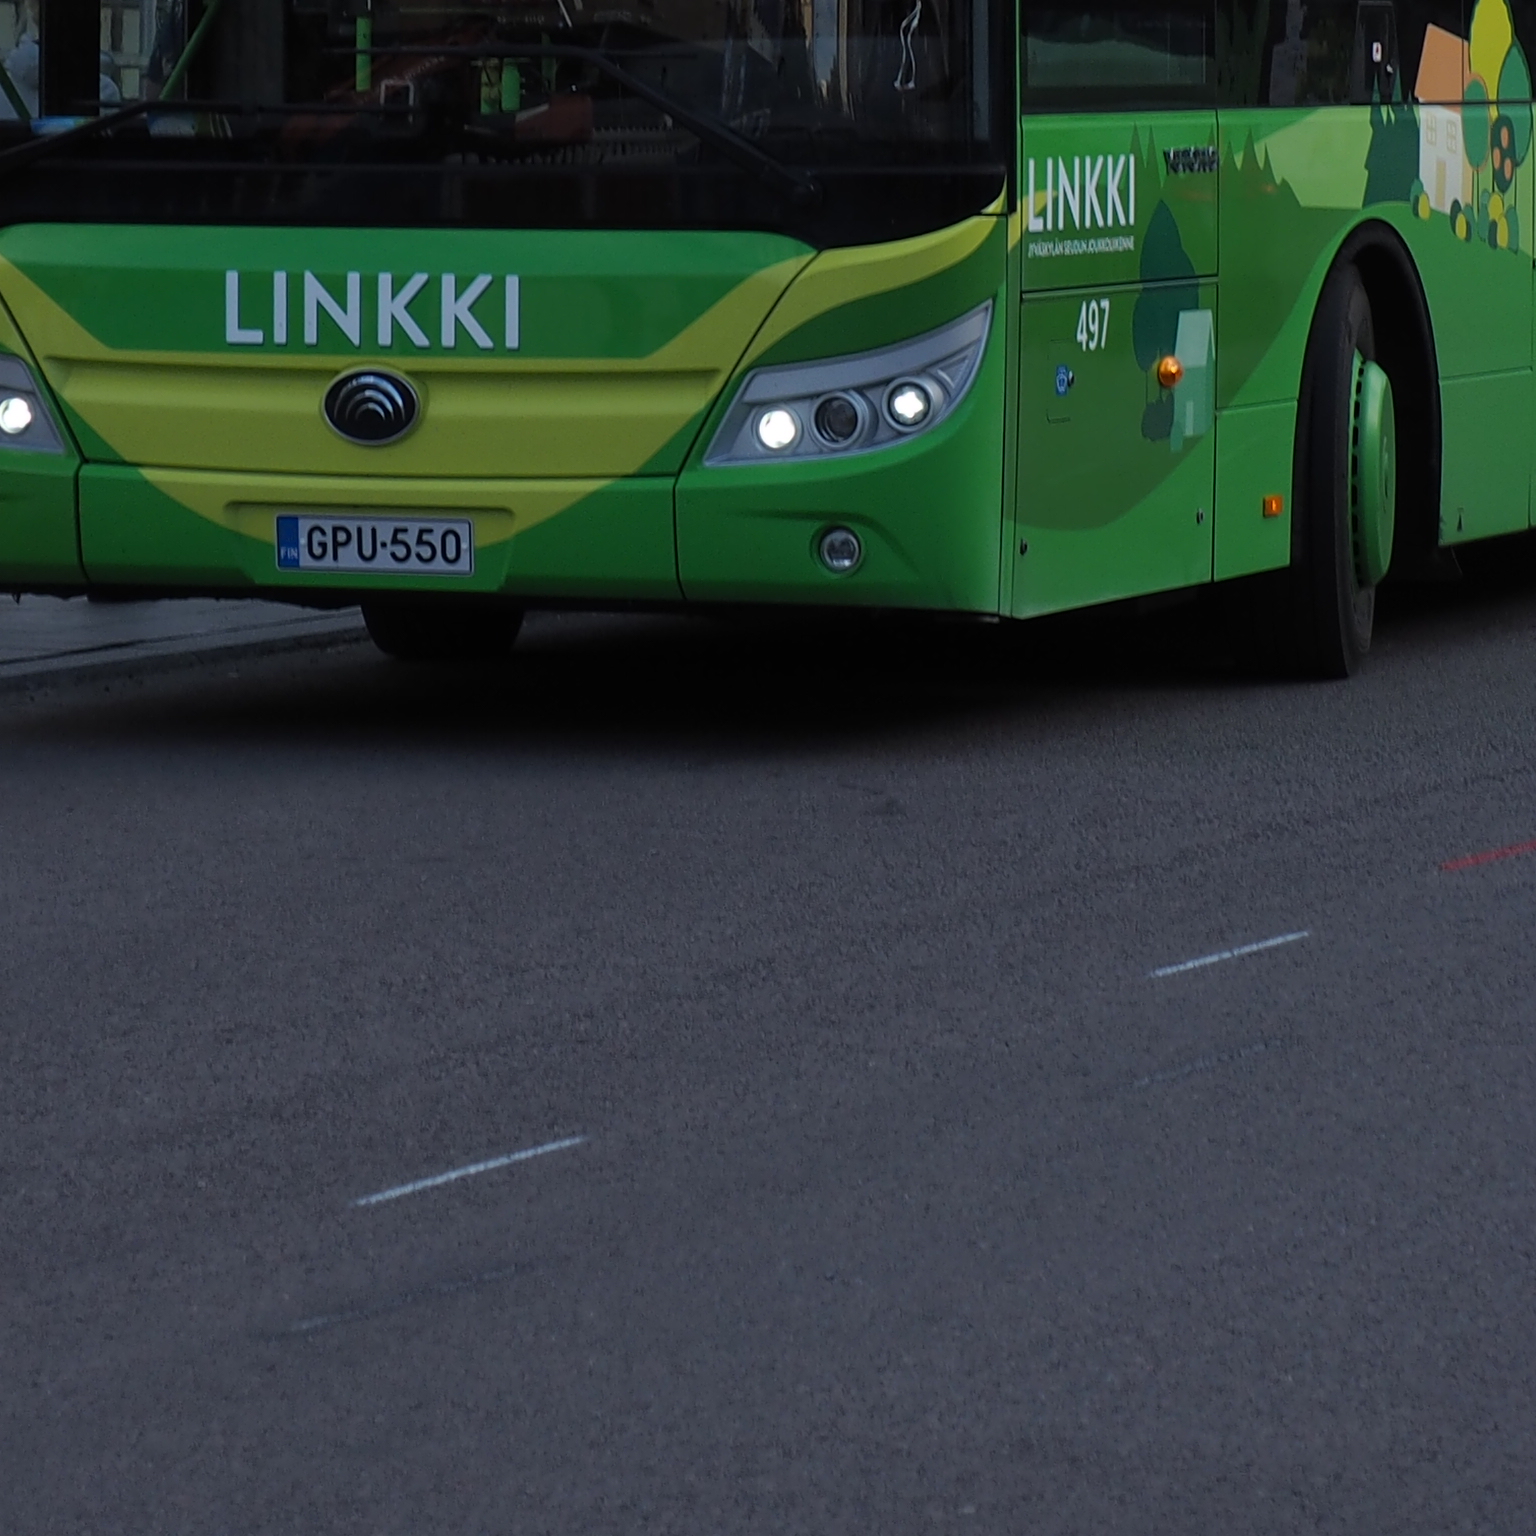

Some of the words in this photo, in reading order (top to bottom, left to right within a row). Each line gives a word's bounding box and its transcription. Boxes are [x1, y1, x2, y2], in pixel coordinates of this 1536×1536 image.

[1027, 153, 1135, 233] LINKKI
[225, 269, 520, 350] LINKKI
[1075, 298, 1111, 352] 497
[280, 545, 298, 560] FIN
[307, 526, 462, 564] GPU-550
